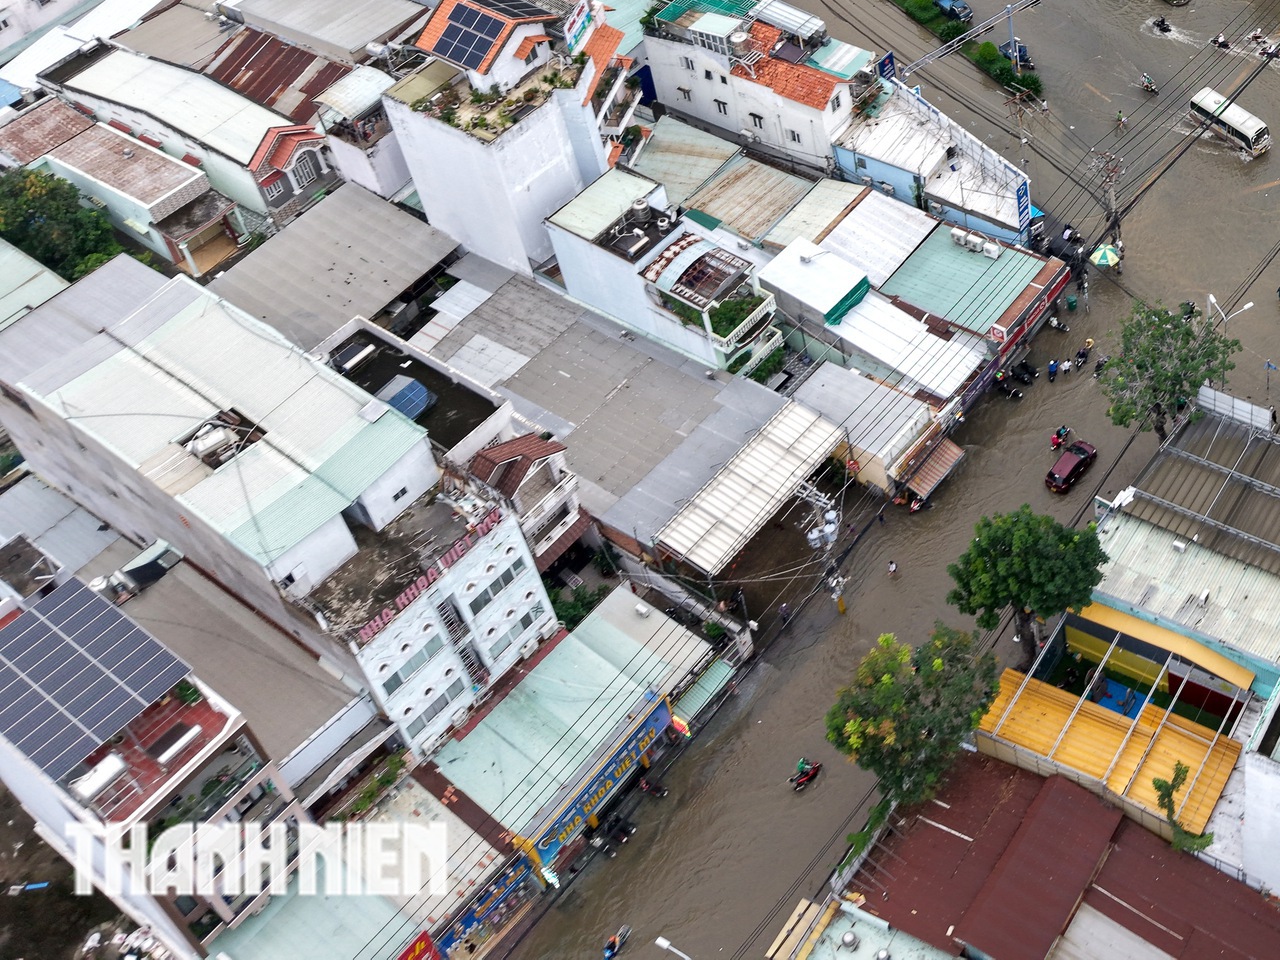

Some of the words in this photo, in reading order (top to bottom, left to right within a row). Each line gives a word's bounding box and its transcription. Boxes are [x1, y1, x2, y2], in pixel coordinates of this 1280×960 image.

[358, 607, 394, 641] NHA
[395, 567, 439, 610] KHOA
[558, 815, 583, 843] NHA
[583, 779, 614, 815] KHOA
